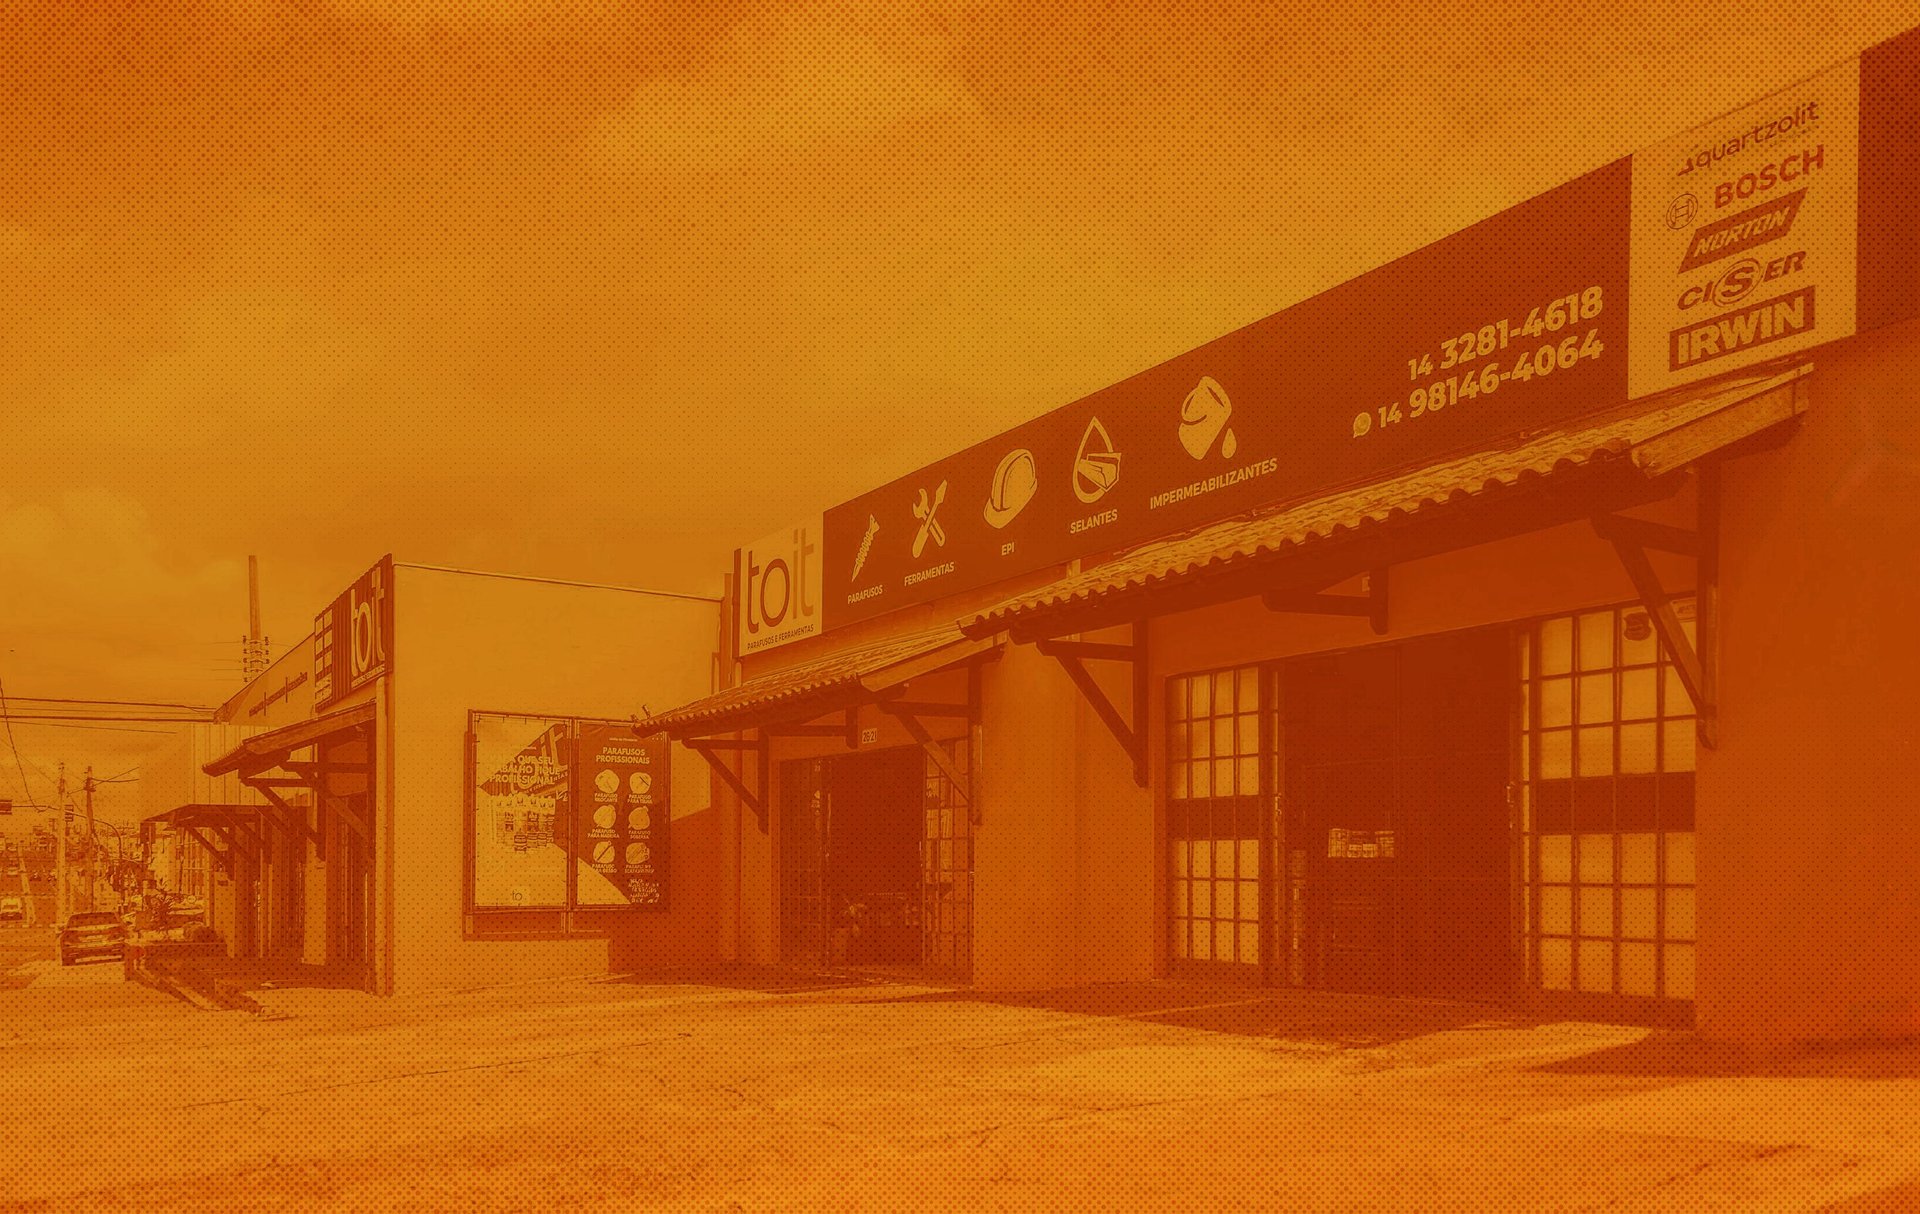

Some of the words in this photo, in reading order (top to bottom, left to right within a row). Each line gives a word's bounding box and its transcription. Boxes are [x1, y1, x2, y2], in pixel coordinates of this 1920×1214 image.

[1695, 101, 1820, 170] quartzolit
[1714, 144, 1824, 209] BOSCH
[1692, 205, 1791, 258] NORTON
[1677, 250, 1807, 311] CISER
[1407, 353, 1434, 381] 14
[1439, 285, 1604, 370] 3281-4618
[1677, 294, 1806, 365] IRWIN
[1377, 402, 1403, 428] 14
[1408, 327, 1605, 419] 98146-4064
[1149, 457, 1279, 511] IMPERMEABILIZANTES
[1069, 508, 1119, 535] SELANTES
[903, 562, 955, 587] FERRAMENTAS
[1000, 541, 1016, 557] EPI
[747, 528, 814, 634] toit
[847, 584, 884, 605] PARAFUSOS
[747, 635, 775, 650] PARAFUSOS
[779, 623, 815, 642] FERRAMENTAS
[595, 754, 651, 765] PROFISSIONAIS
[602, 746, 646, 757] PARAFUSOS
